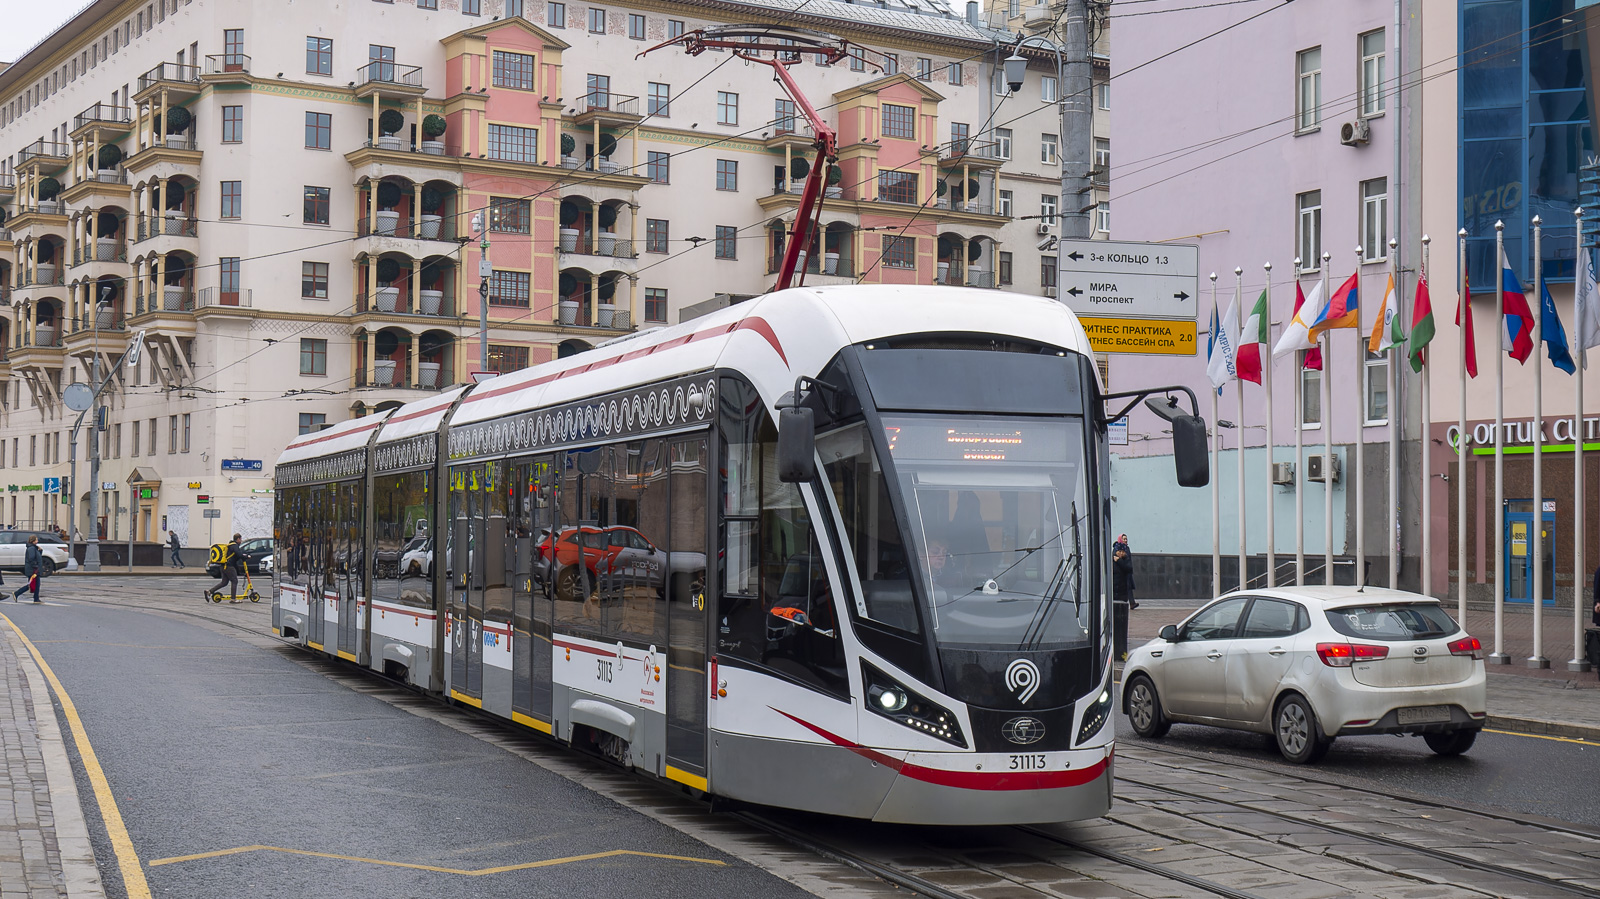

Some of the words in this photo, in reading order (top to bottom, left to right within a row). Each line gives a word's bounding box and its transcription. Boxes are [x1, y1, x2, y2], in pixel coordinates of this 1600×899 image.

[1090, 252, 1104, 262] 3-е
[1107, 253, 1149, 265] КОЛЬЦО
[1155, 256, 1169, 265] 1.3
[1089, 282, 1118, 292] МИРА
[1089, 295, 1134, 304] проспект
[1122, 326, 1172, 336] ПРАКТИКА
[1116, 337, 1156, 347] БАССЕЙН
[1157, 339, 1175, 347] СПА
[1179, 334, 1193, 342] 2.0
[596, 658, 613, 684] 31113
[1008, 754, 1046, 770] 31113
